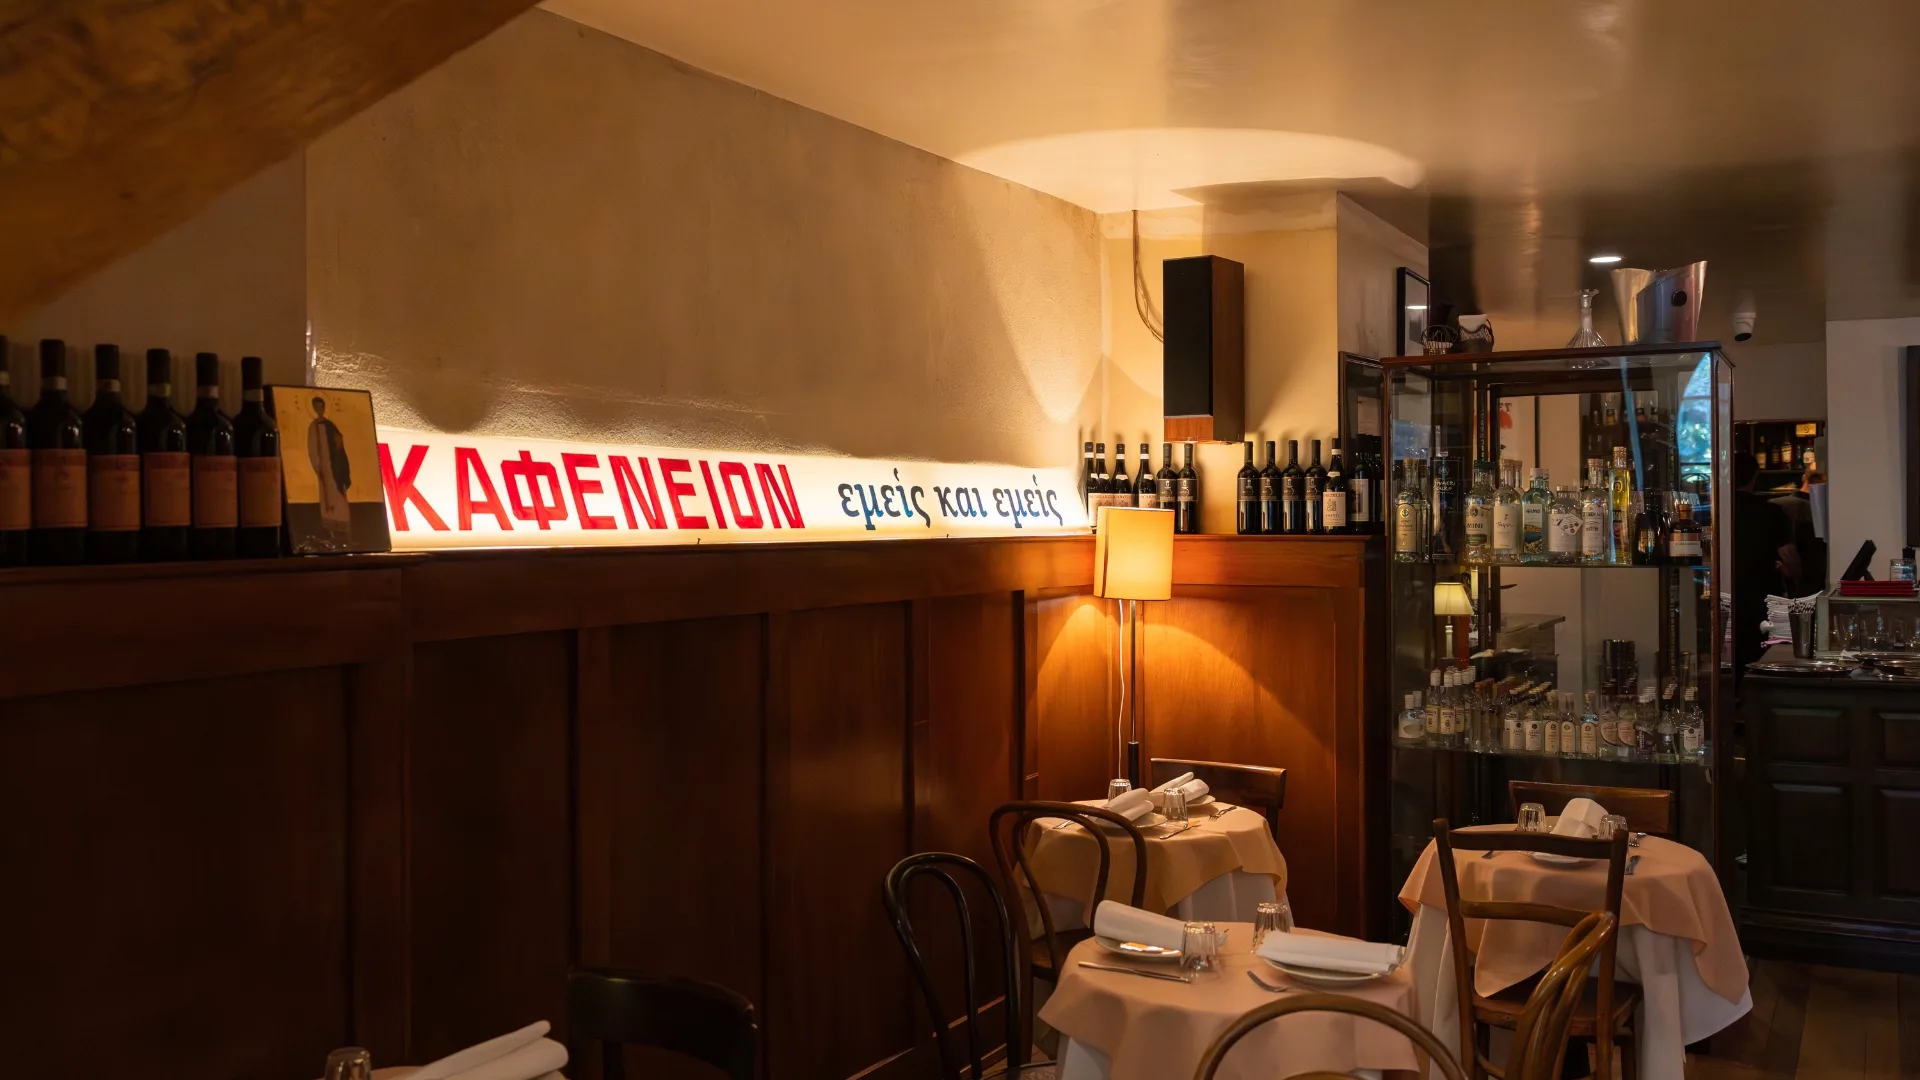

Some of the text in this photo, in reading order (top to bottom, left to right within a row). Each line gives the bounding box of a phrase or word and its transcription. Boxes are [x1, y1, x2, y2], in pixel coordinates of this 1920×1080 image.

[378, 443, 805, 531] ΚΑΦΕΝΕΙΟΝ
[837, 467, 1064, 531] εμείς και εμείς
